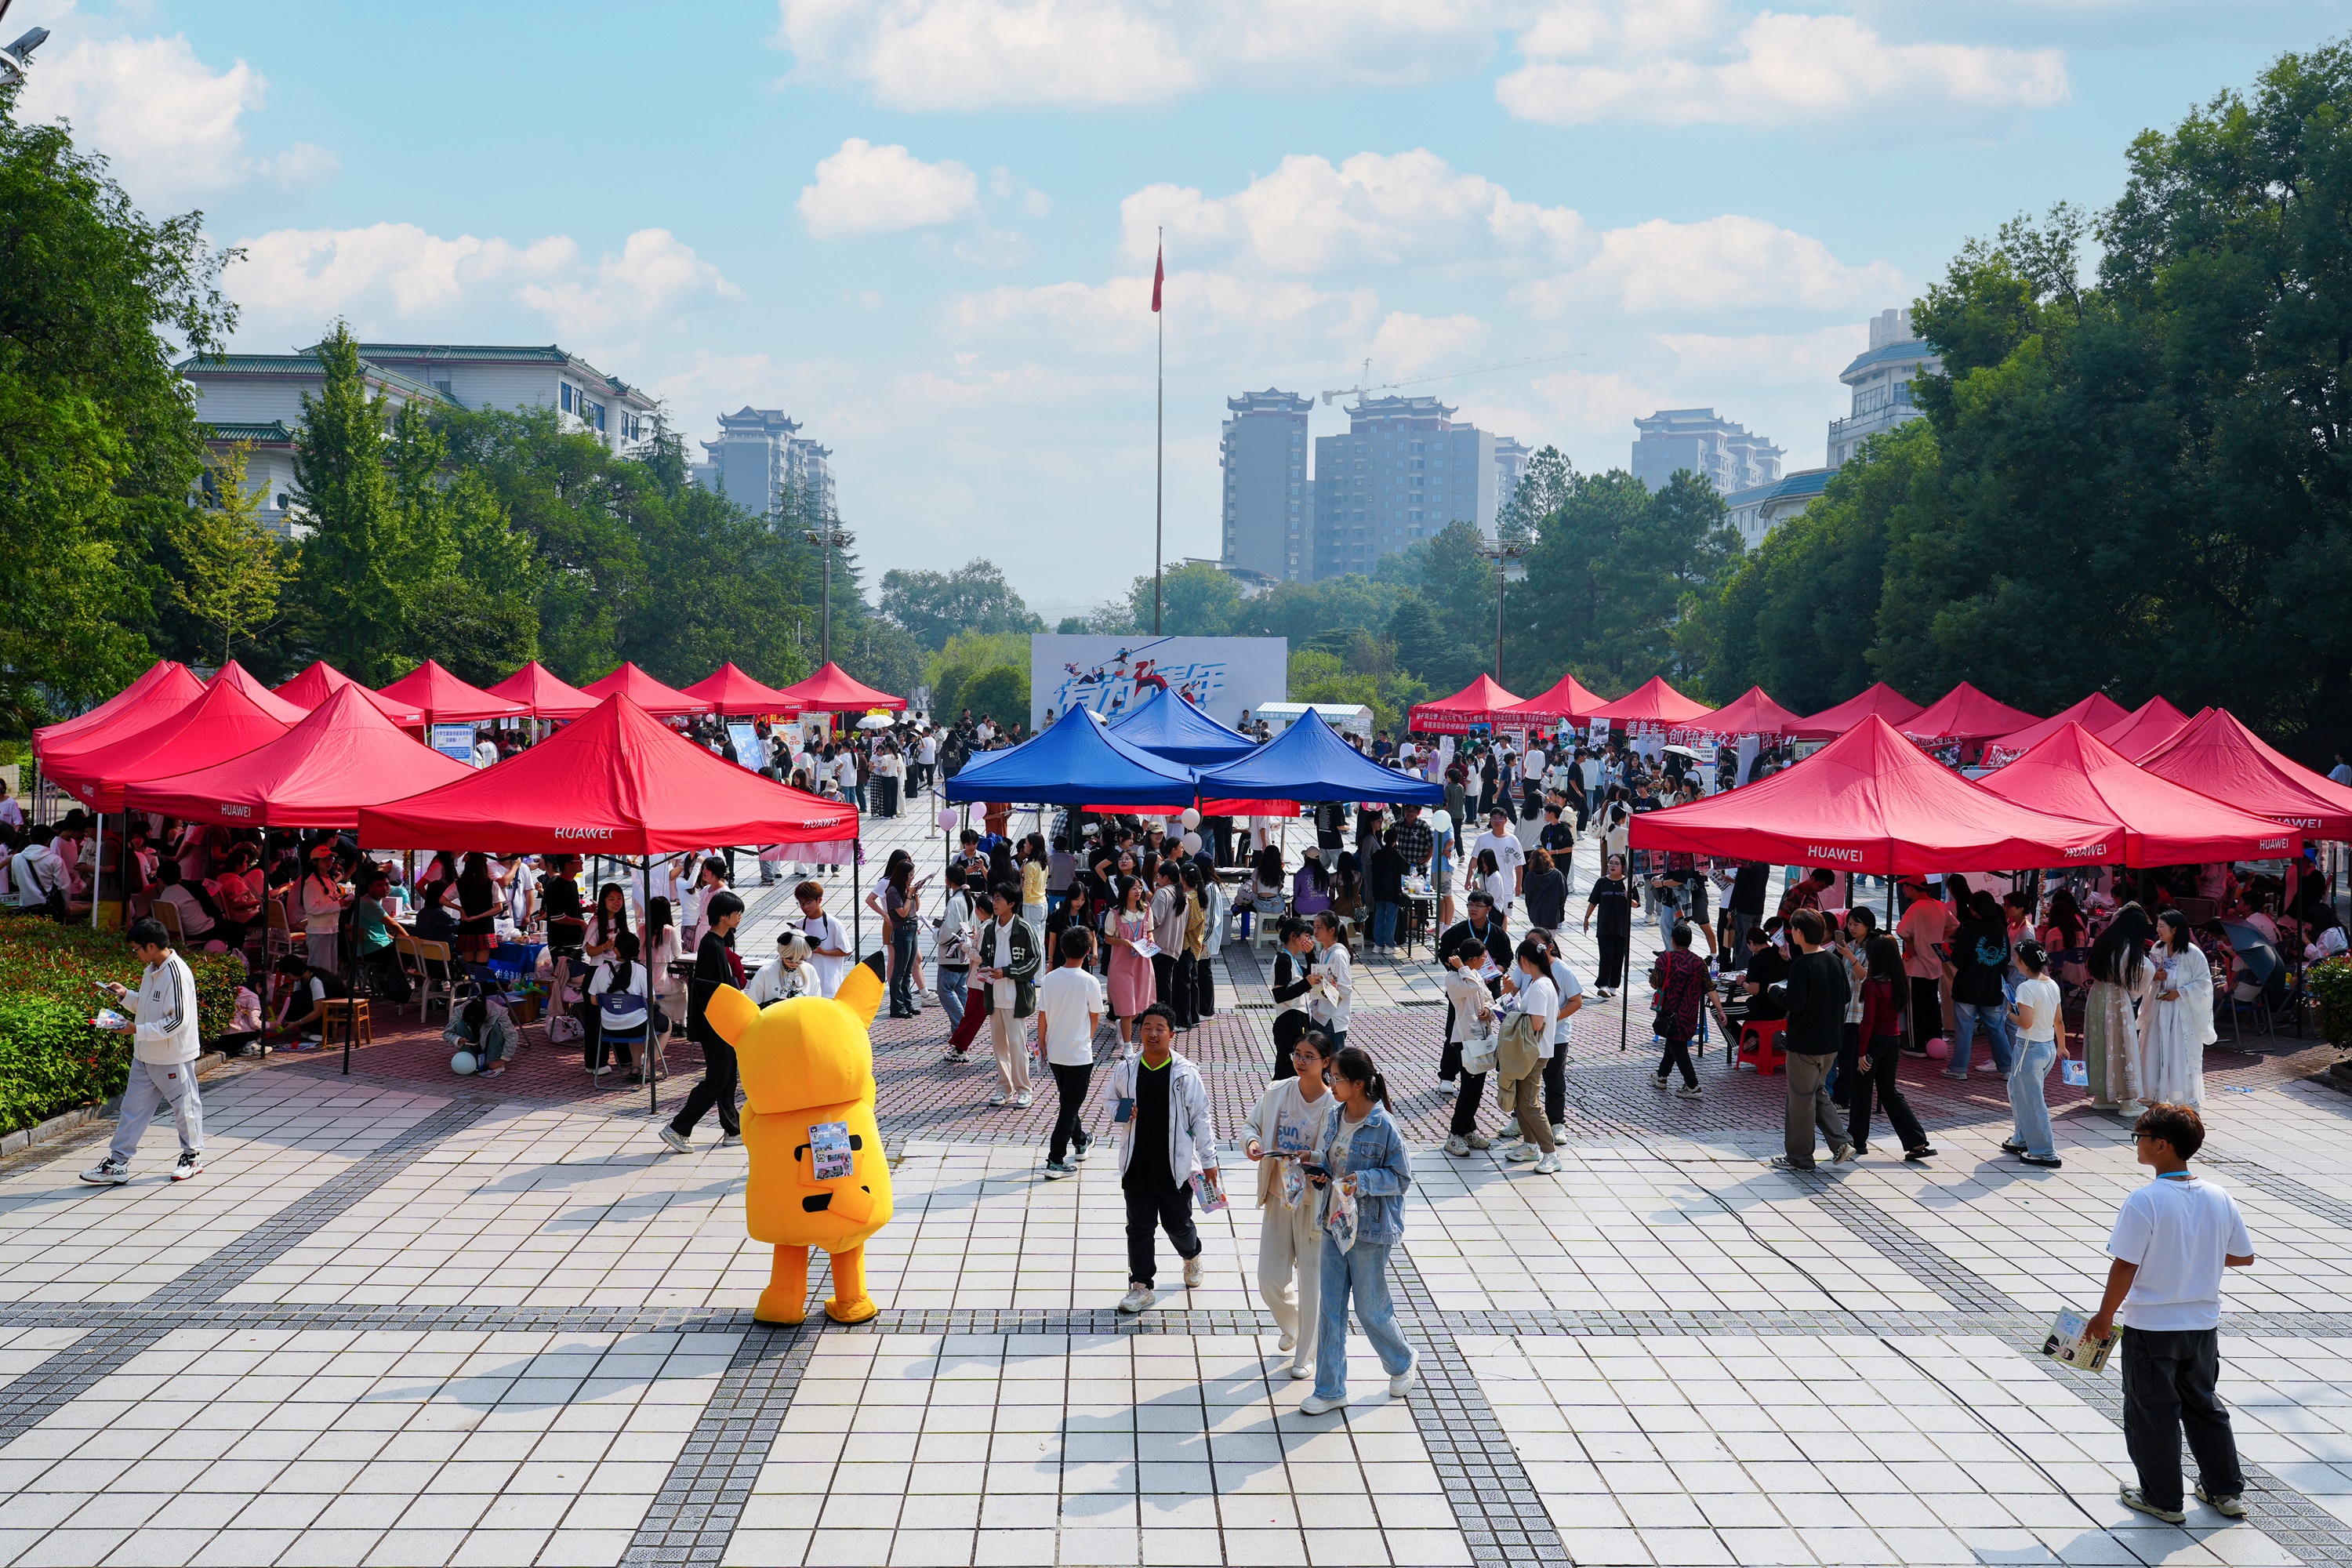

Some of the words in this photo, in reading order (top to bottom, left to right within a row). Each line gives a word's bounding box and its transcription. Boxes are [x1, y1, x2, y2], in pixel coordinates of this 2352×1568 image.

[221, 803, 252, 818] HUAWEI
[801, 817, 841, 829] HUAWEI
[554, 827, 614, 839] HUAWEI
[2065, 844, 2107, 858] HUAWEI
[2259, 838, 2289, 851] HUAWEI
[1808, 845, 1864, 862] HUAWEI
